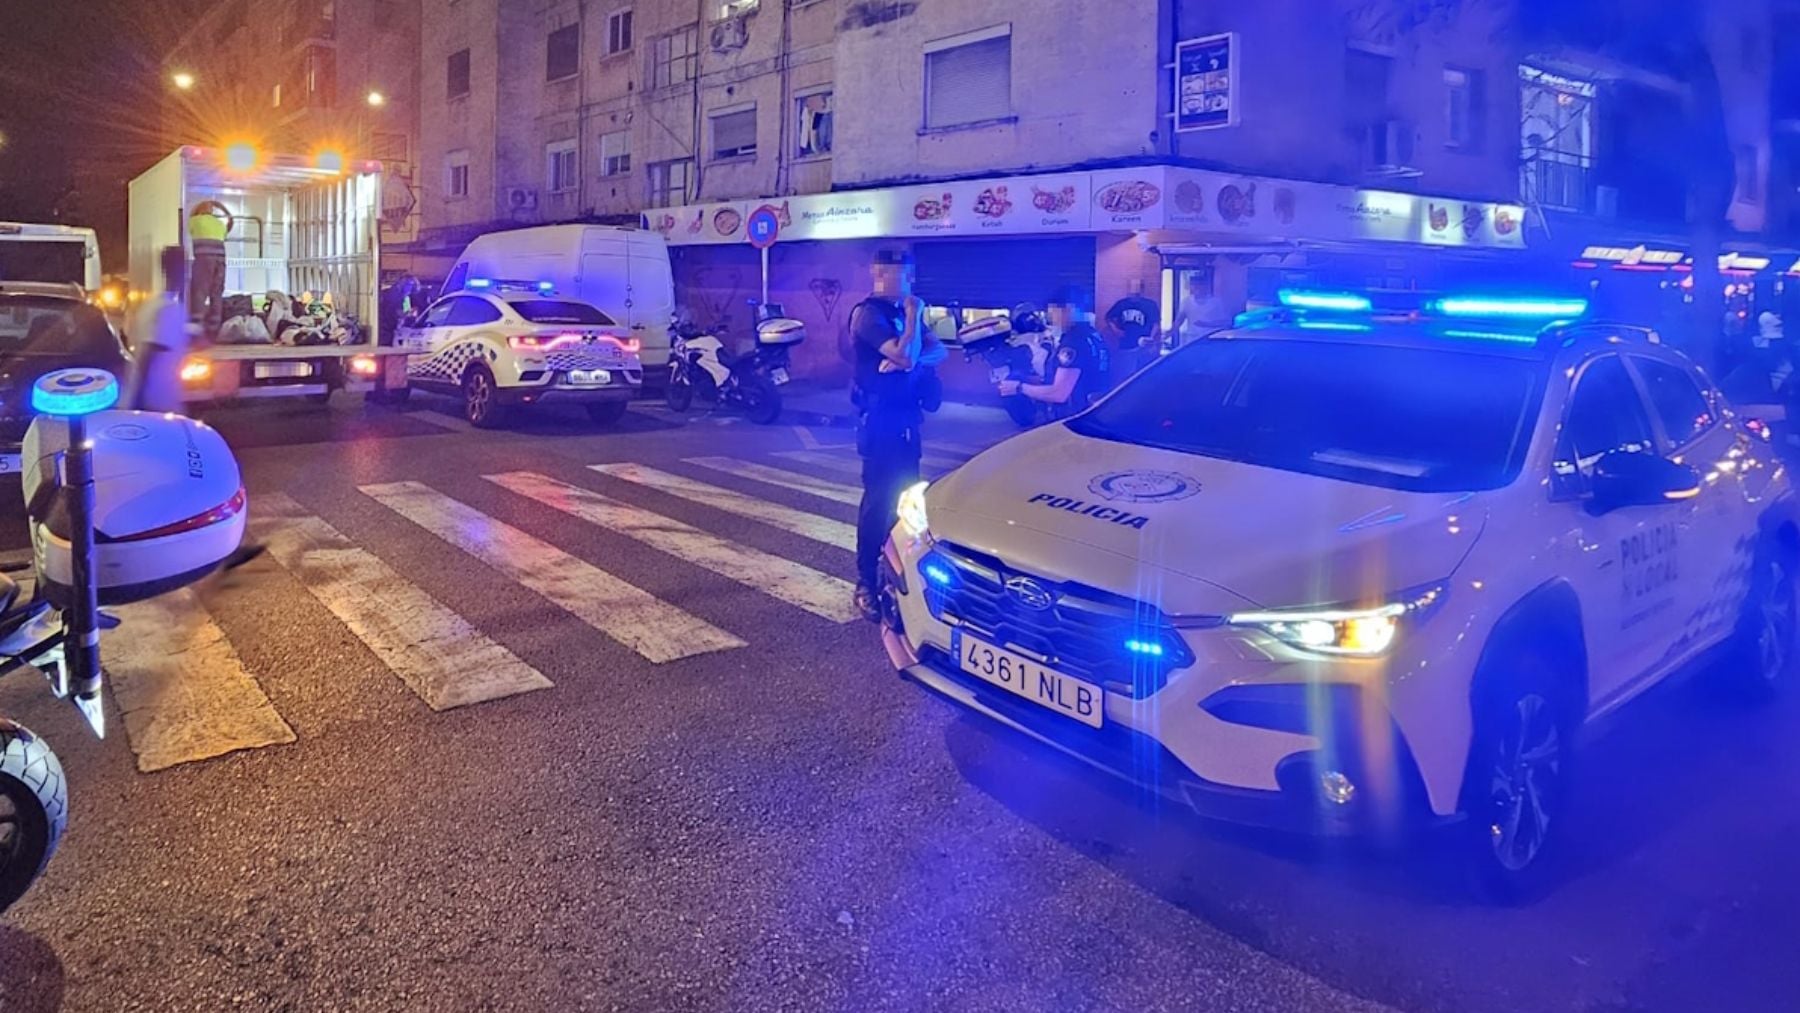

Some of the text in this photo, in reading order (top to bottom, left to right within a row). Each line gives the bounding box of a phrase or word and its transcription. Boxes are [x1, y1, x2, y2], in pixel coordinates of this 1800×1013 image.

[1028, 493, 1149, 529] POLICIA
[1621, 521, 1677, 569] POLICIA
[1635, 556, 1678, 598] LOCAL
[967, 643, 1093, 716] 4361 NLB
